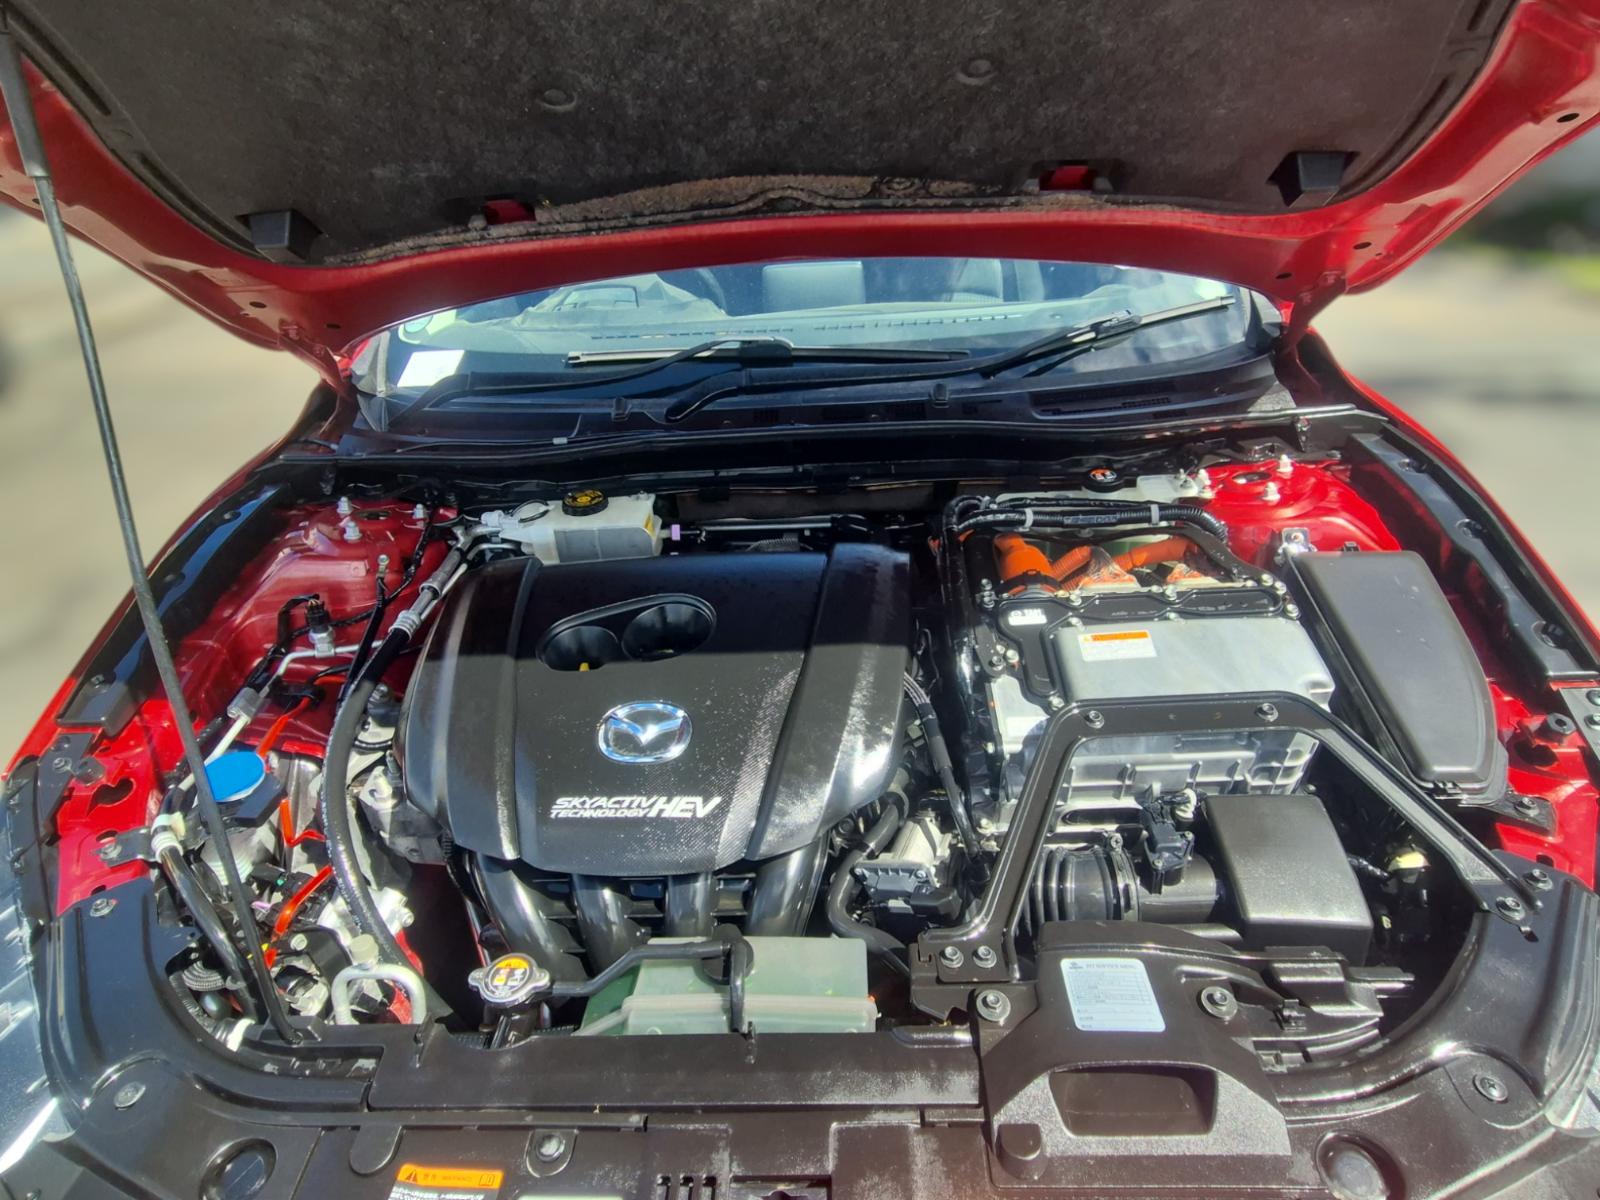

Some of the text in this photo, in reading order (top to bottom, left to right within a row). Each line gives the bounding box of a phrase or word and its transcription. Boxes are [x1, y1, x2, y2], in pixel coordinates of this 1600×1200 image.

[552, 796, 657, 809] SKYACTIV
[646, 796, 722, 818] HEV
[550, 808, 650, 819] TECHNOLOGY
